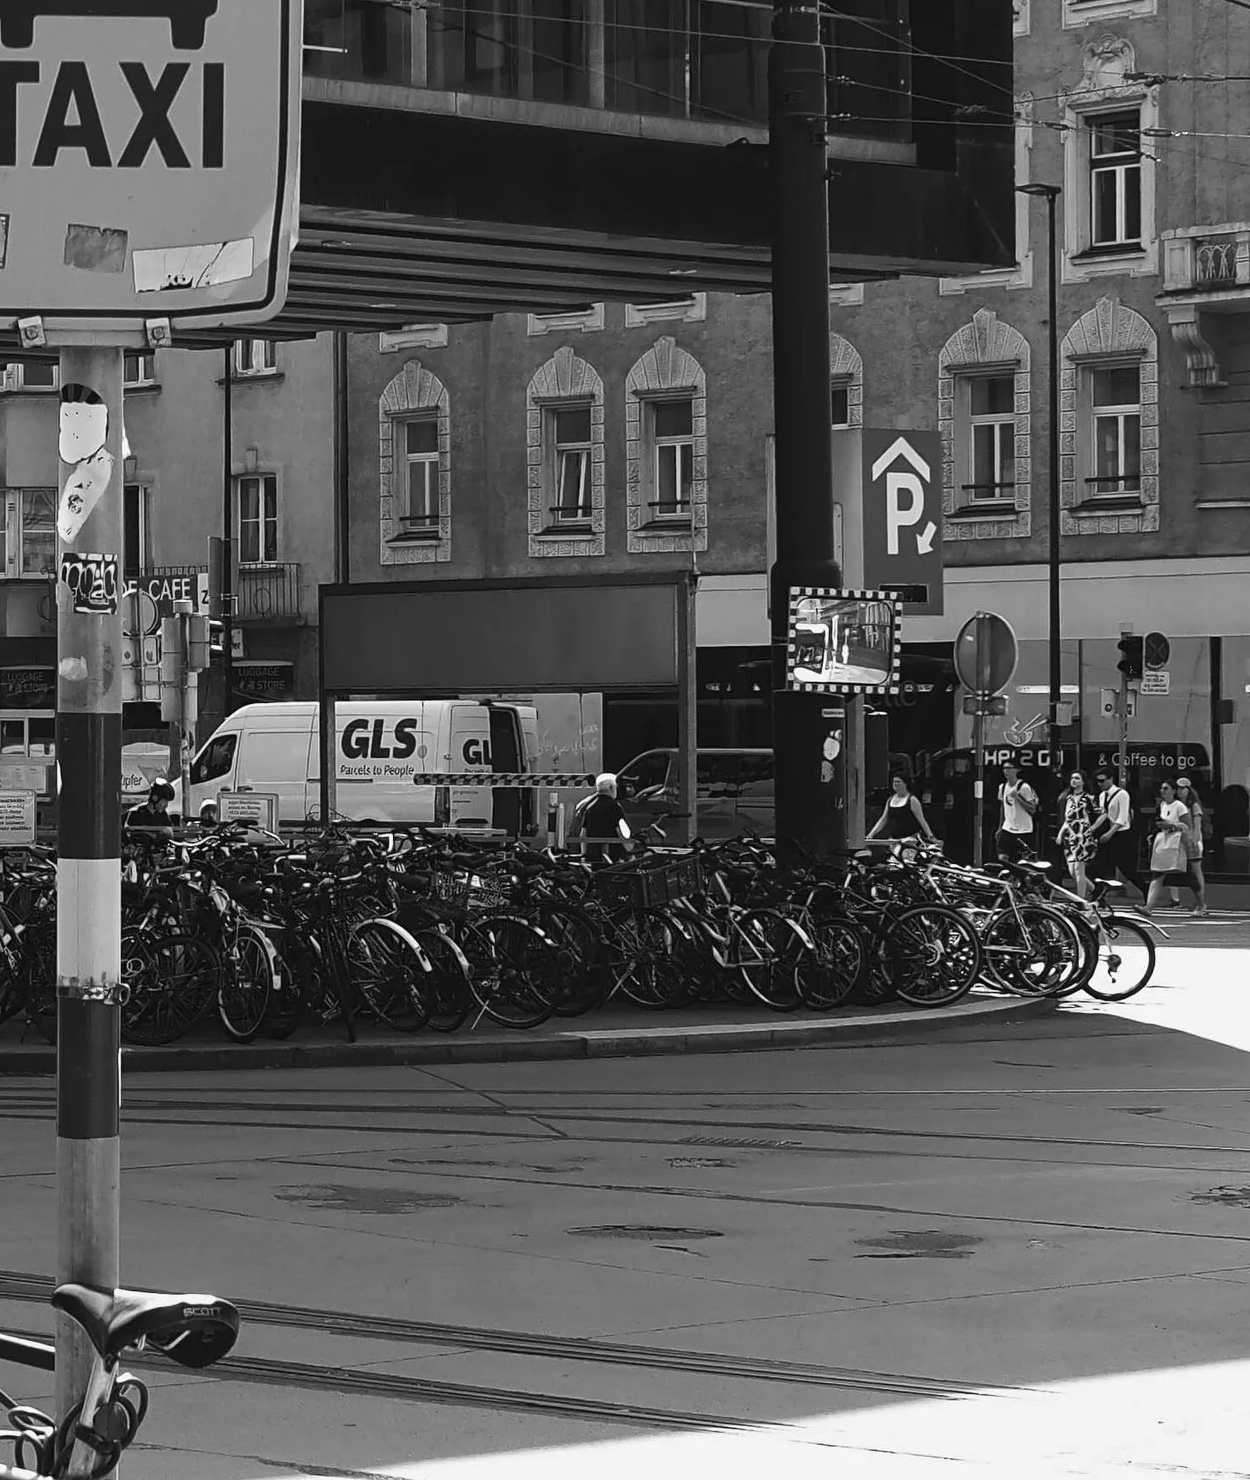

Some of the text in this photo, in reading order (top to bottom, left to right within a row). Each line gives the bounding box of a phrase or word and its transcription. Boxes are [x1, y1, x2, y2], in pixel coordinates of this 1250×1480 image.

[886, 472, 925, 555] P
[148, 578, 191, 601] CAFE
[238, 667, 280, 677] LUGGAGE
[256, 679, 285, 690] STORE
[341, 718, 418, 759] GLS
[1020, 749, 1034, 766] 2
[1098, 752, 1196, 770] & Coffee to go
[340, 764, 415, 778] Parcels to People
[182, 1306, 222, 1318] SCOTT
